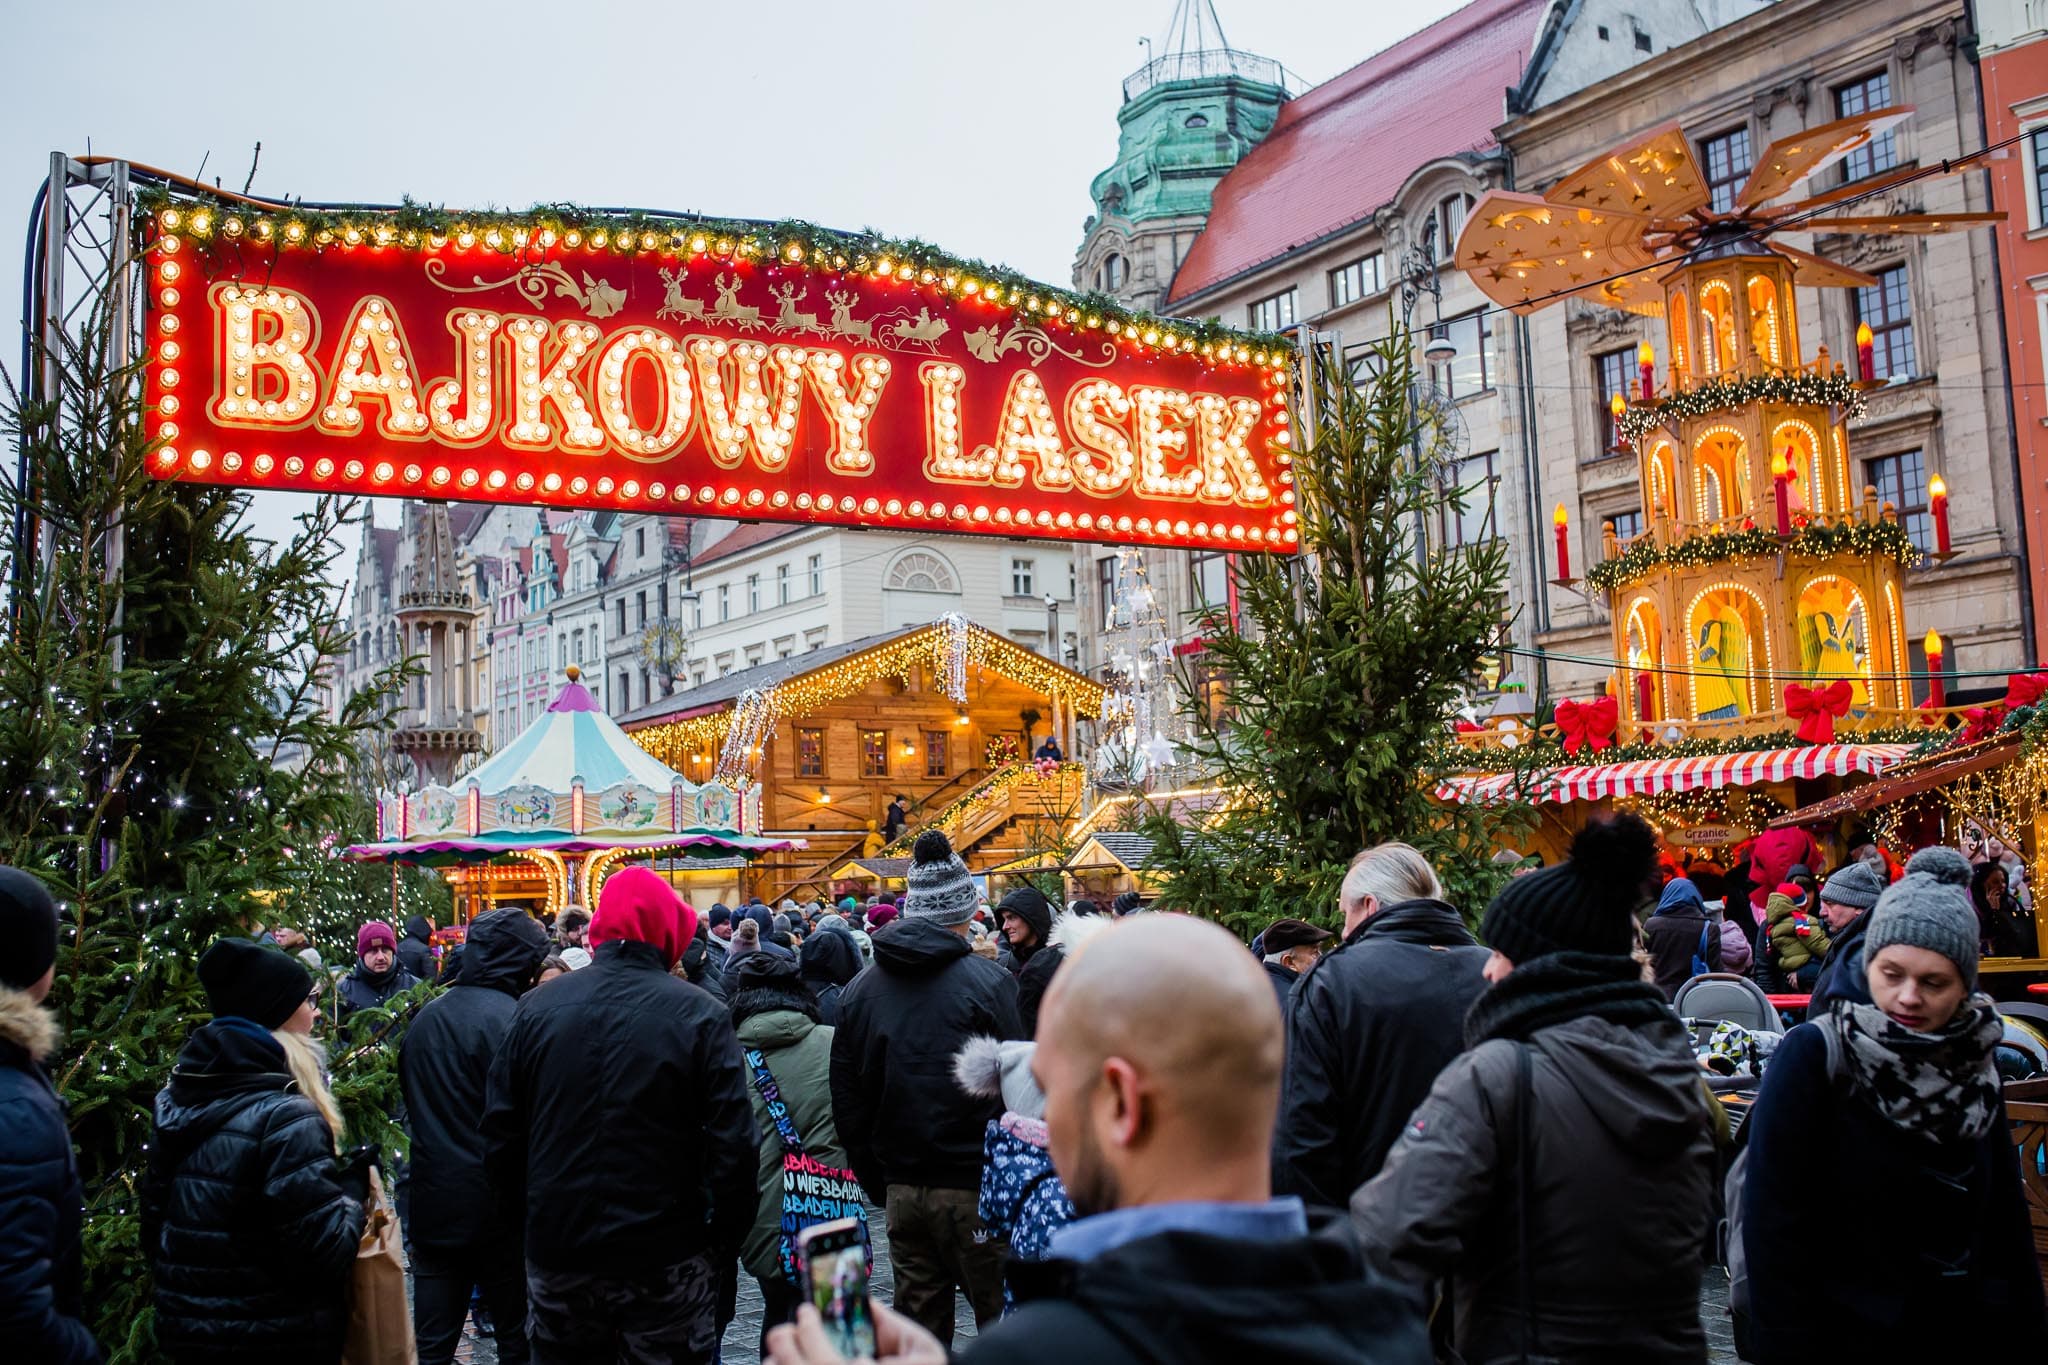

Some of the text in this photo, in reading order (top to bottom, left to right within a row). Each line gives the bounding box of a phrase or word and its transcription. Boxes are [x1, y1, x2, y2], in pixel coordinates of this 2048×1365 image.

[206, 281, 1275, 508] BAJKOWY LASEK
[1684, 827, 1730, 839] Grzaniec
